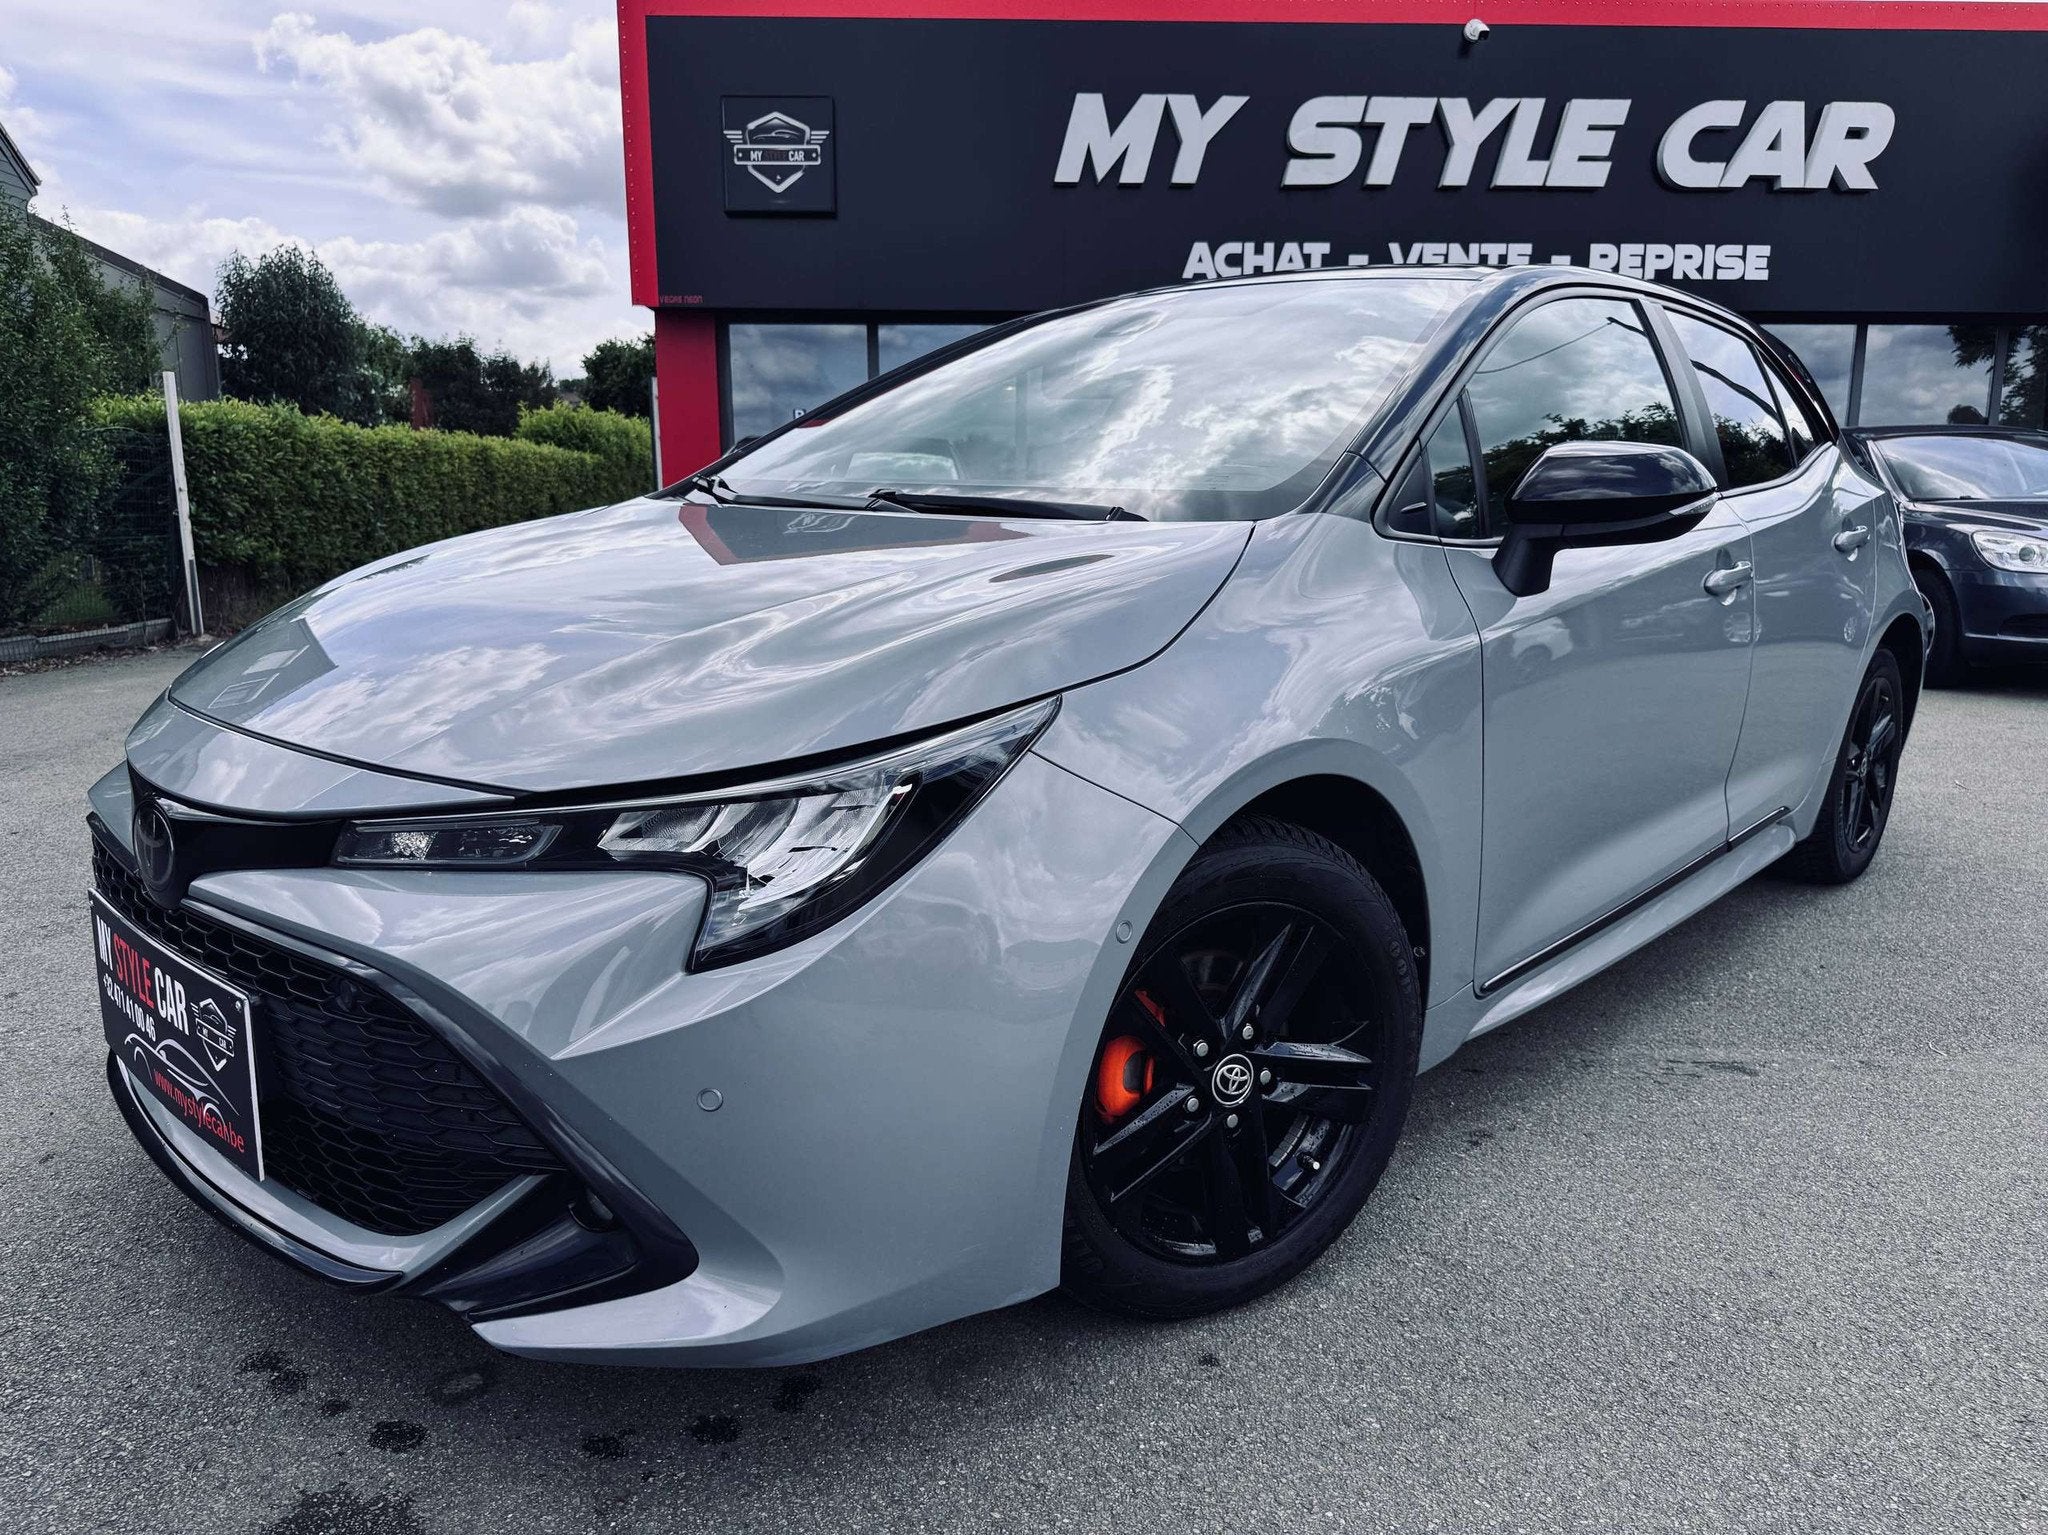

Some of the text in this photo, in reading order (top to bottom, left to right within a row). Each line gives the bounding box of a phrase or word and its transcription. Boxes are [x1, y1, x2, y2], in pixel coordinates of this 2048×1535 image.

[749, 150, 763, 162] MY
[788, 150, 805, 162] CAR
[1053, 92, 1896, 192] MY STYLE CAR
[1182, 241, 1331, 279] ACHAT
[1388, 242, 1533, 266] VENTE
[1589, 243, 1772, 281] REPRISE
[96, 914, 190, 1036] MY STYLE CAR
